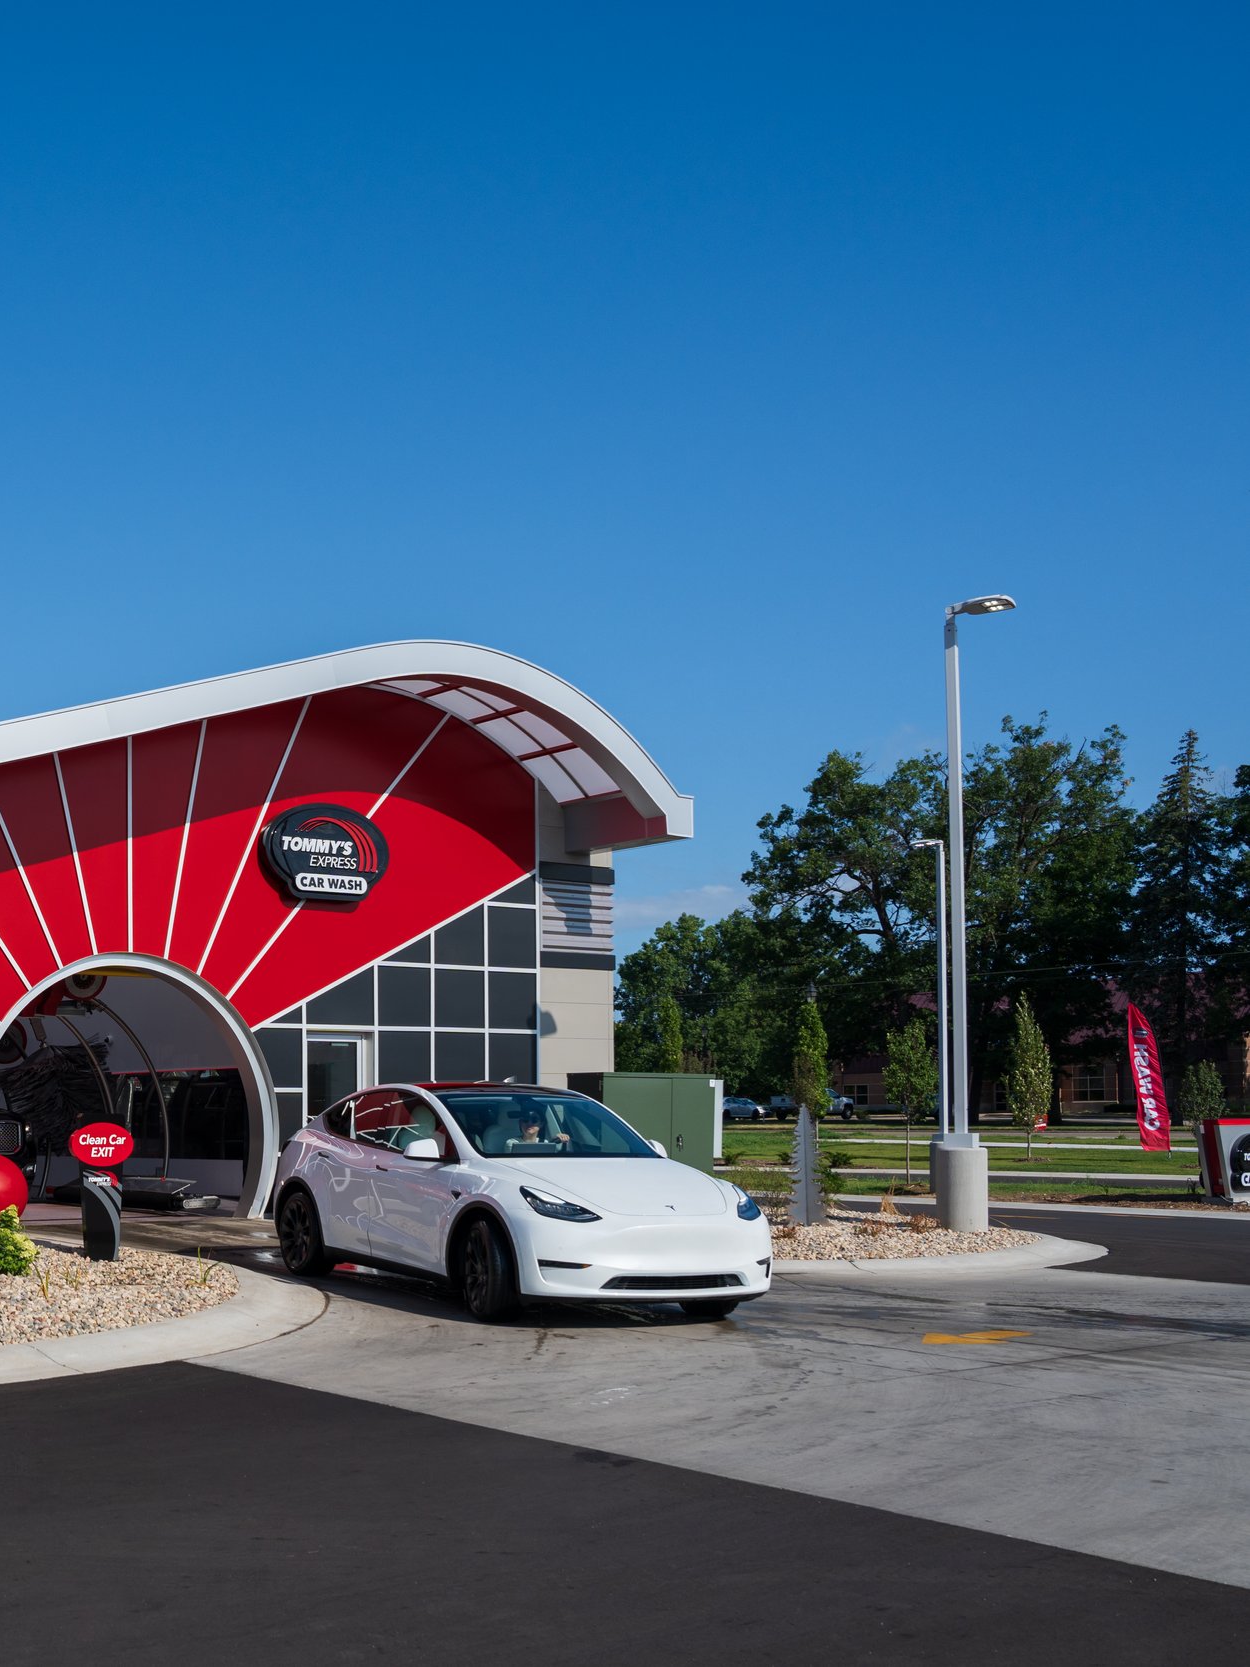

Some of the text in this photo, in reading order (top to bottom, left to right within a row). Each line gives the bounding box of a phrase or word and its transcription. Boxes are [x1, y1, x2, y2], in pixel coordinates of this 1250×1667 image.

[282, 836, 353, 855] TOMMY'S
[309, 854, 357, 869] EXPRESS
[300, 876, 362, 891] CAR WASH
[79, 1134, 126, 1145] Clean Car
[91, 1147, 115, 1157] EXIT
